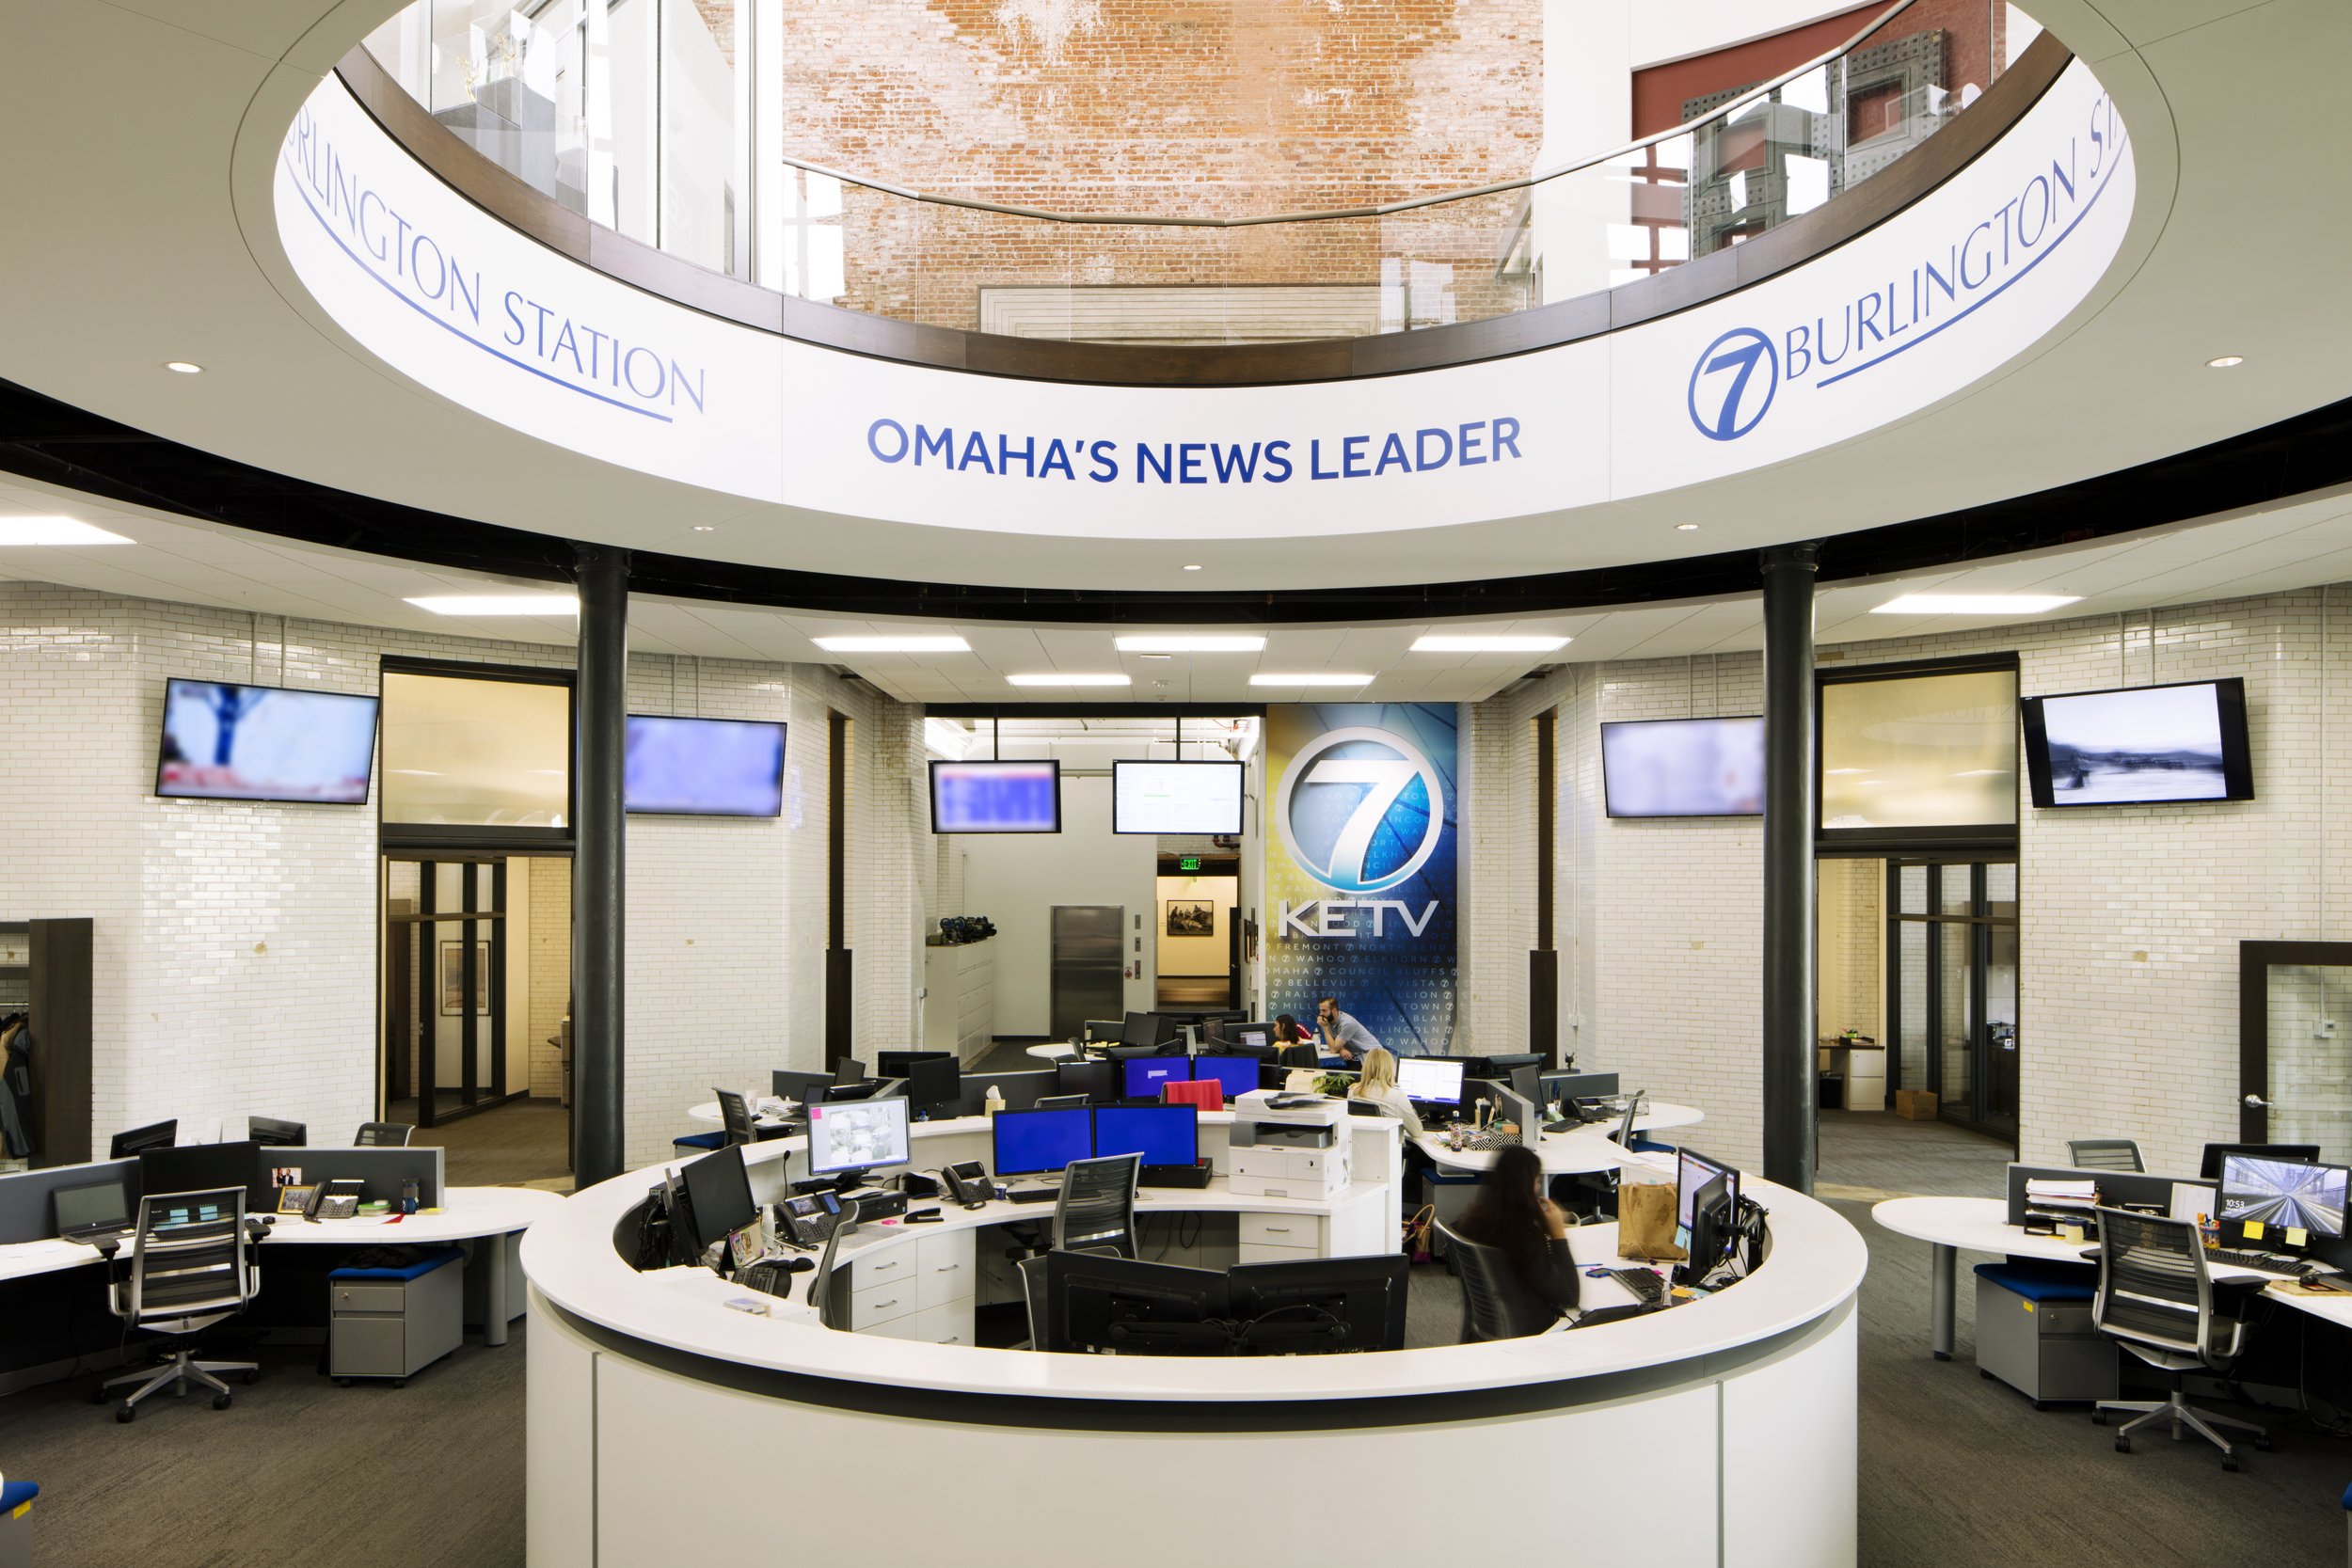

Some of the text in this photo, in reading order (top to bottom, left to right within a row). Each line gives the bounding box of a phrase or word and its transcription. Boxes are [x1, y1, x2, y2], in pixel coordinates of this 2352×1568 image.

[1786, 136, 2076, 381] BURLINGTON
[503, 291, 706, 415] STATION
[866, 417, 1522, 484] OMAHA'S NEWS LEADER
[1183, 859, 1198, 869] EXIT
[1279, 900, 1439, 938] KETV
[1329, 967, 1389, 975] COUNCIL
[2226, 1199, 2245, 1209] 10:53
